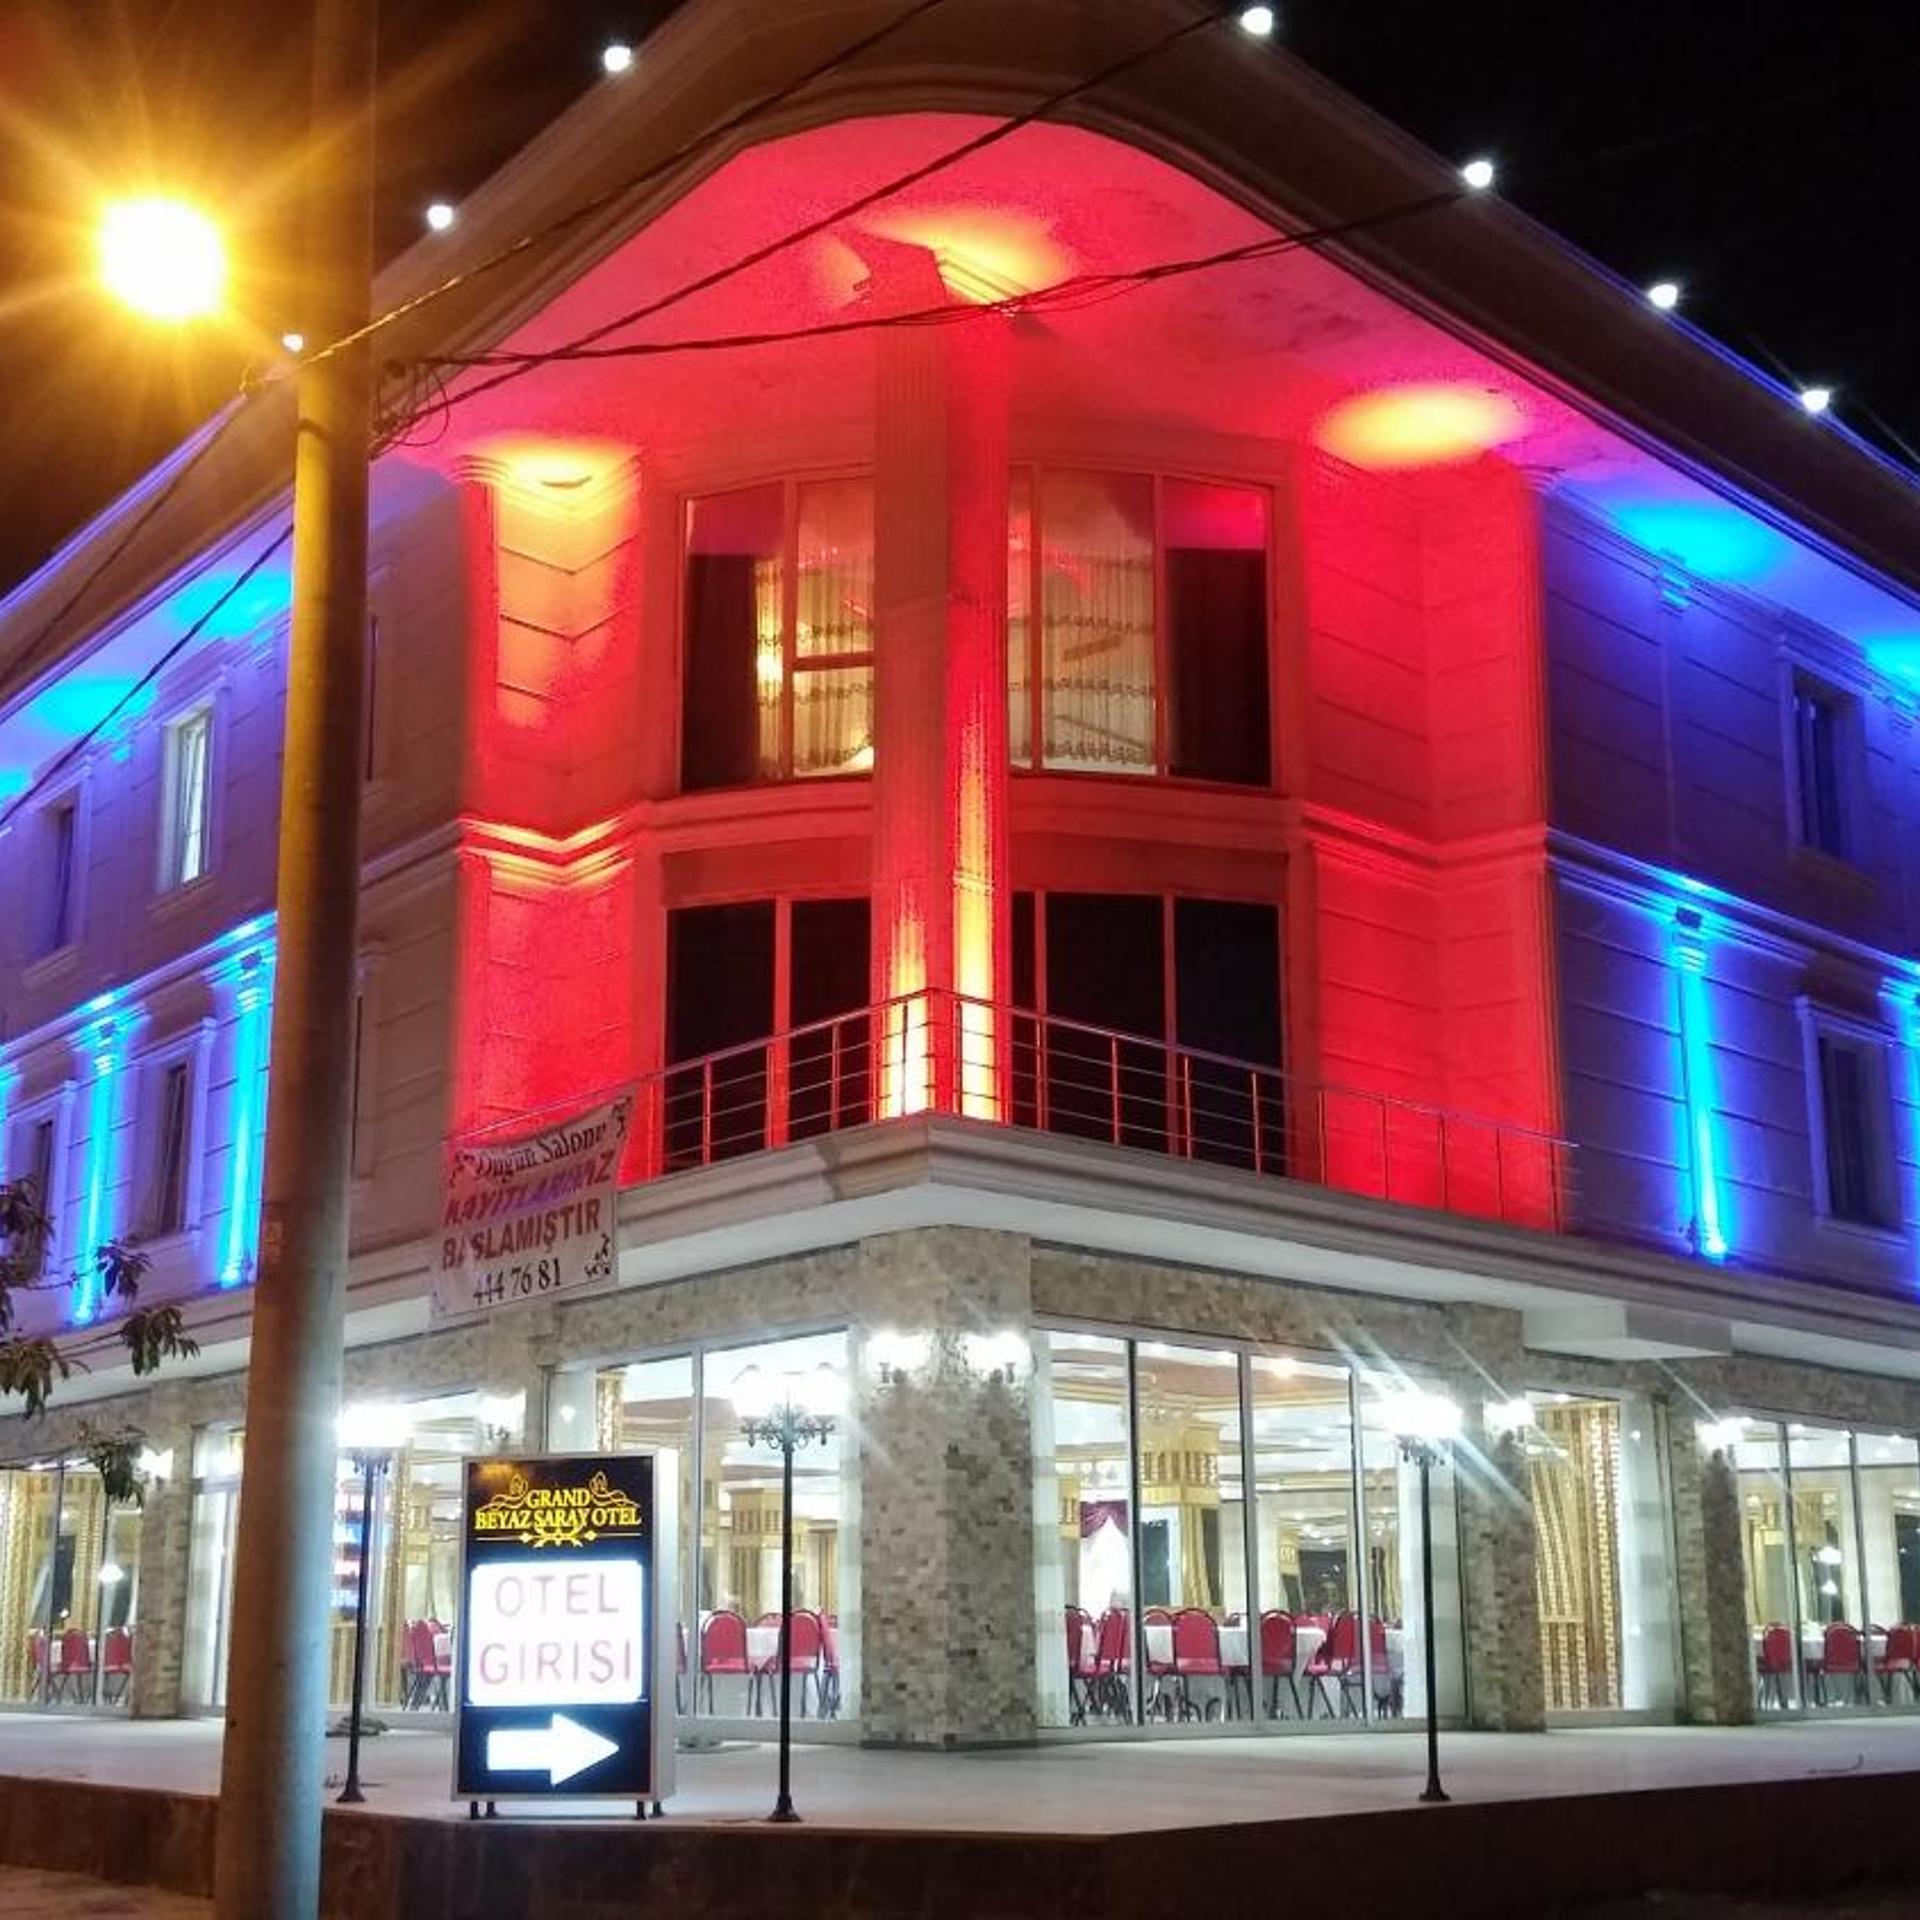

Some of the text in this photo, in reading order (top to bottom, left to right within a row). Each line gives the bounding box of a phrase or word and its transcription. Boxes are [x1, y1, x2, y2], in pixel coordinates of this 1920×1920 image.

[511, 1262, 532, 1295] 76
[538, 1257, 561, 1288] 81
[527, 1489, 591, 1508] GRAND
[475, 1507, 641, 1529] BEYAZ SARAY OTEL
[495, 1573, 619, 1617] OTEL
